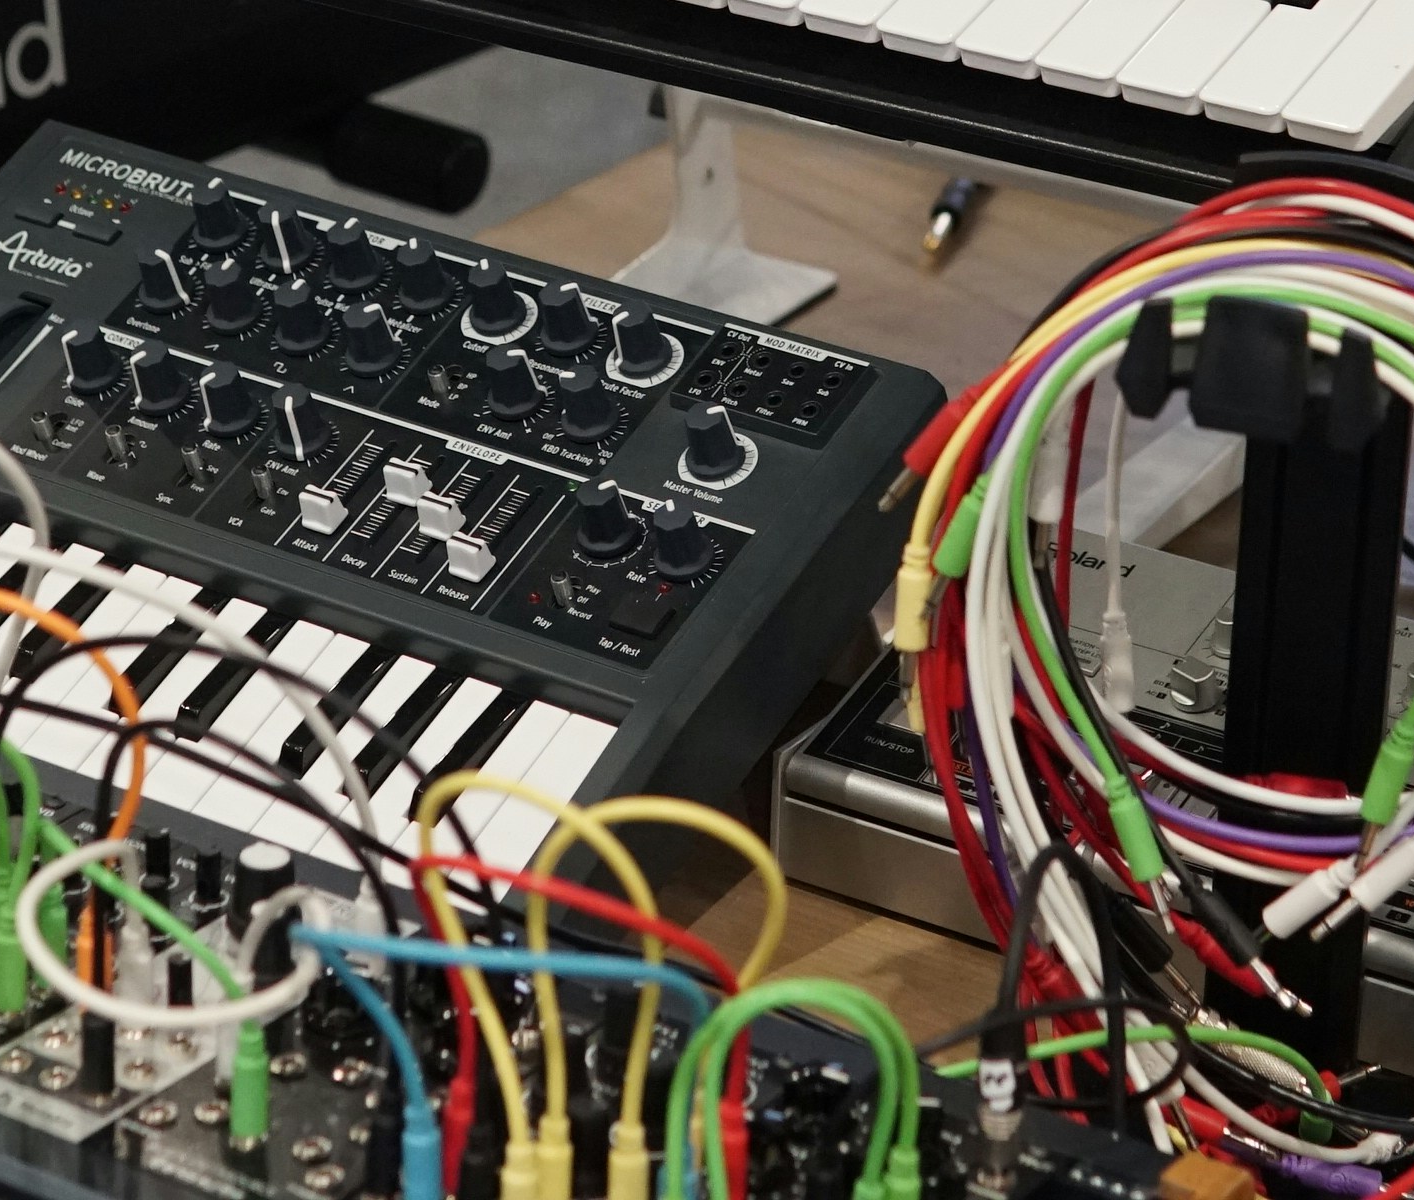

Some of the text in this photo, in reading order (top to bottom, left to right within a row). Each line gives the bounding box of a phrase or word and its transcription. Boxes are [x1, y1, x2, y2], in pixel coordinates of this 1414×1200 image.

[59, 148, 194, 199] MICROBRUT
[584, 297, 616, 312] FILTER
[126, 317, 161, 334] Overtone
[387, 316, 423, 334] Metalizer
[727, 330, 752, 343] CV Out
[462, 340, 490, 354] Cutoff
[764, 337, 822, 359] MOD MATRIX
[711, 358, 726, 367] ENV
[834, 360, 845, 369] CV
[743, 367, 763, 378] Metal
[780, 378, 795, 387] Saw
[619, 385, 646, 400] Factor
[688, 387, 702, 396] LFO
[816, 388, 830, 398] Sub
[417, 395, 440, 409] Mode
[720, 396, 738, 407] Pitch
[755, 406, 775, 418] Filter
[128, 417, 158, 431] Amount
[477, 423, 513, 440] ENV Amt
[542, 432, 555, 441] Off
[52, 438, 73, 449] Cutoff
[202, 440, 222, 451] Rate
[452, 440, 503, 462] ENVELOPE
[541, 443, 594, 466] KBD Tracking
[597, 449, 613, 459] 200
[207, 465, 219, 474] Seq
[265, 460, 300, 477] ENV Amt
[87, 470, 106, 482] Wave
[190, 484, 204, 494] Free
[277, 487, 289, 496] Env
[662, 479, 724, 504] Master Volume
[156, 493, 174, 505] Sync
[260, 506, 276, 517] Gate
[228, 516, 243, 528] VCA
[292, 538, 319, 553] Attack
[341, 554, 367, 570] Decay
[387, 569, 419, 586] Sustain
[626, 570, 647, 584] Rate
[437, 585, 470, 602] Release
[585, 584, 602, 596] Play
[576, 595, 590, 605] Off
[567, 606, 593, 621] Record
[532, 616, 553, 630] Play
[598, 636, 641, 657] Tap Rest
[864, 735, 915, 755] RUN/STOP
[1404, 900, 1414, 908] 10
